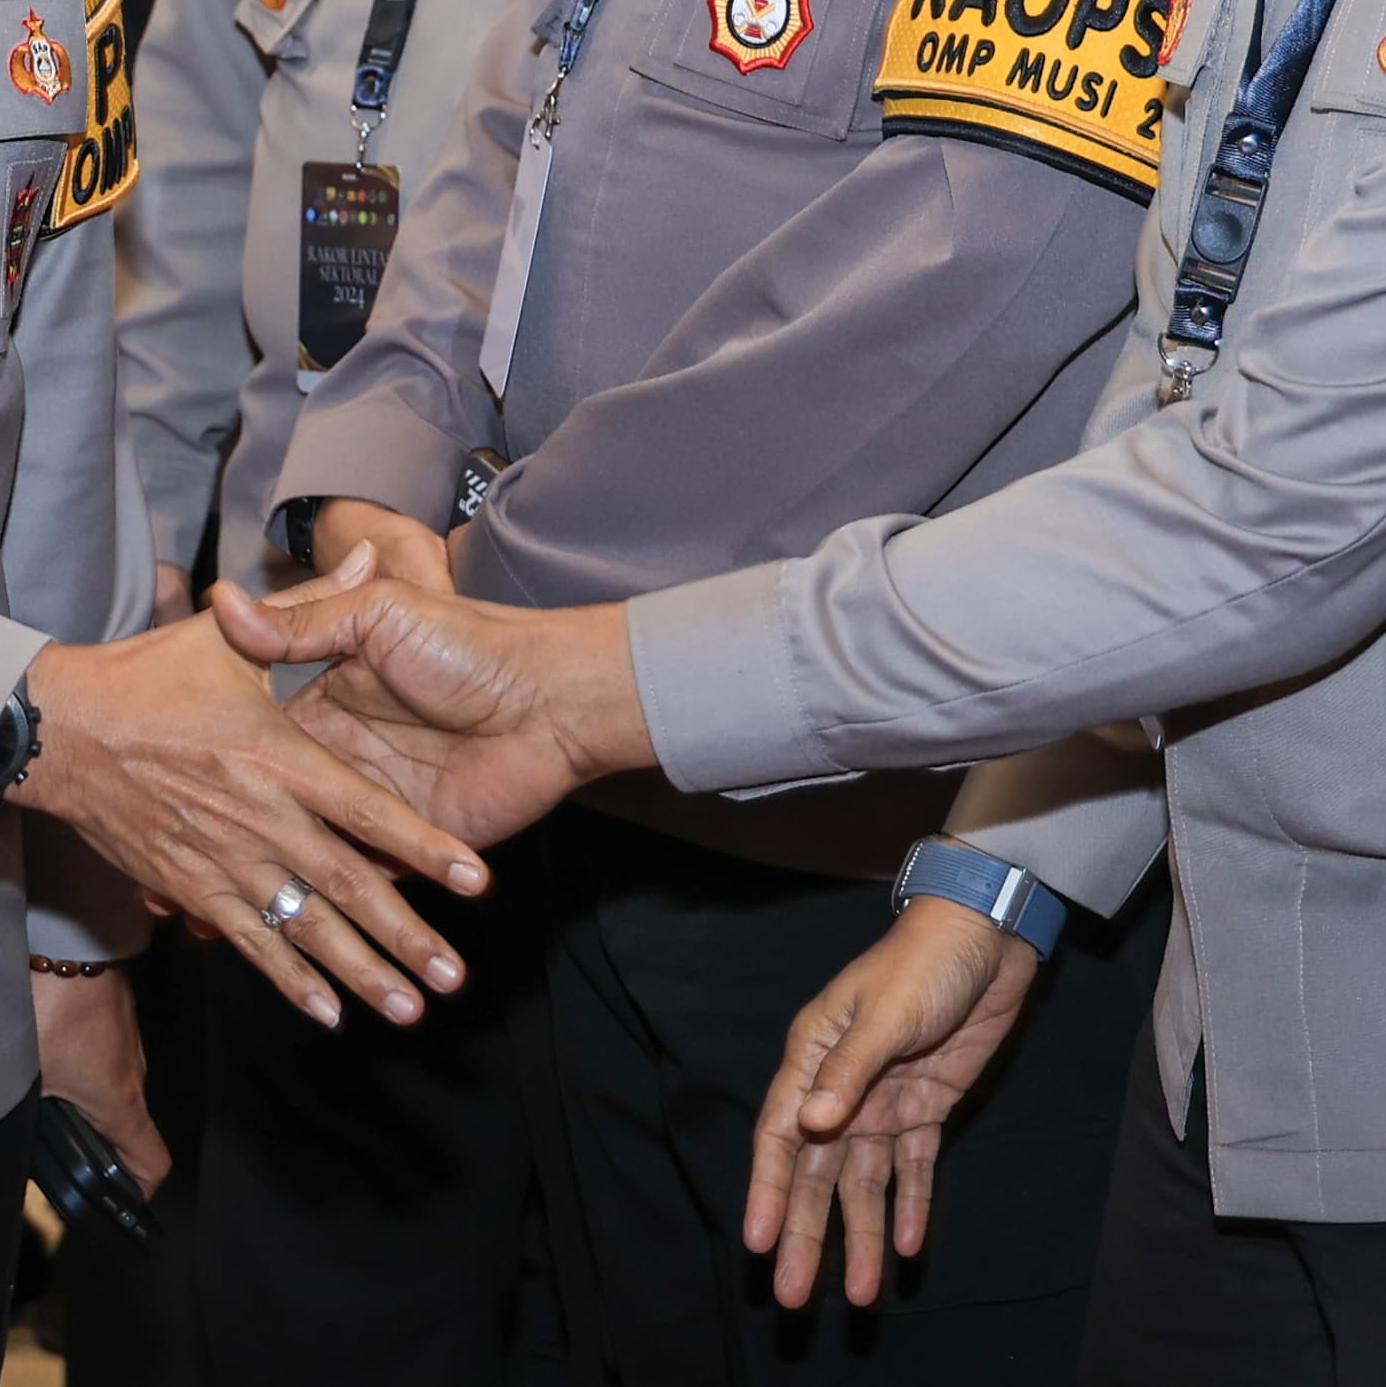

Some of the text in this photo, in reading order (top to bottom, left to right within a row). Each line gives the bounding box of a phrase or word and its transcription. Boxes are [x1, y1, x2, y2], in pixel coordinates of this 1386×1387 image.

[915, 30, 996, 75] OMP
[1005, 43, 1118, 118] MUSI
[333, 285, 365, 310] 2024
